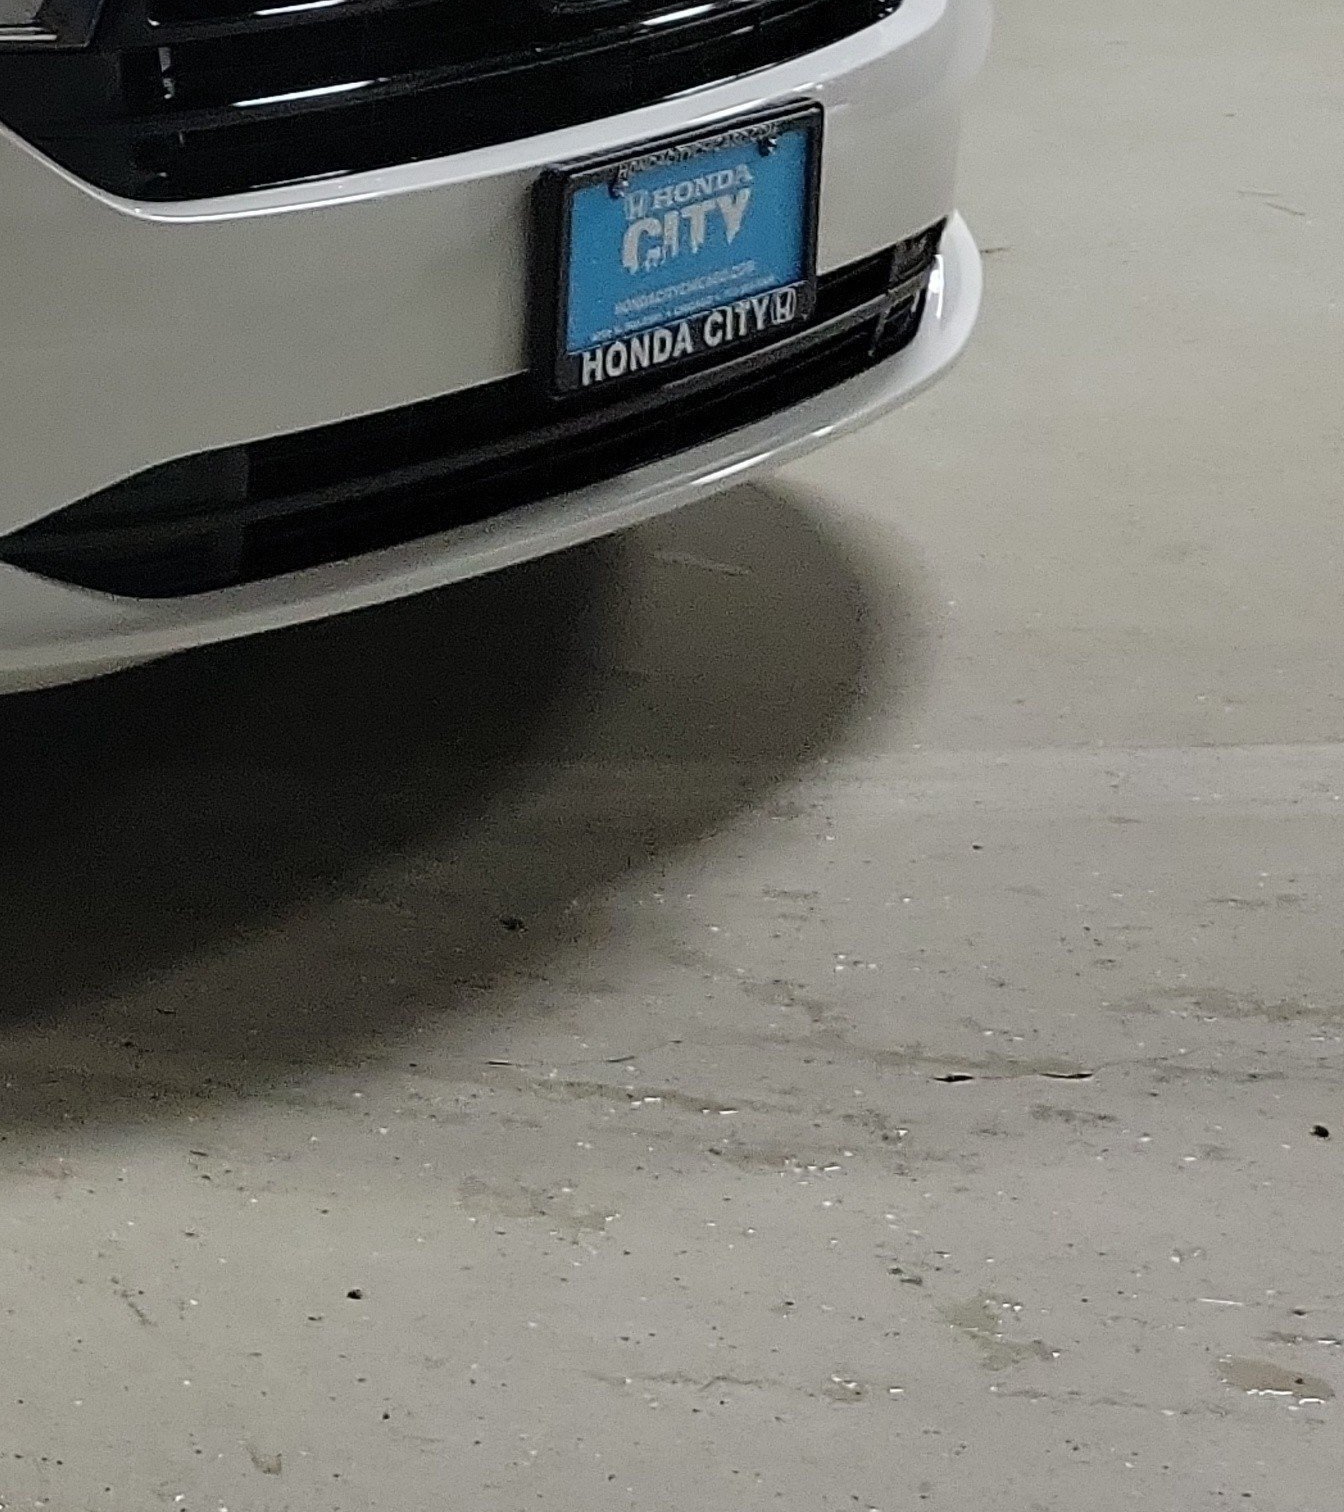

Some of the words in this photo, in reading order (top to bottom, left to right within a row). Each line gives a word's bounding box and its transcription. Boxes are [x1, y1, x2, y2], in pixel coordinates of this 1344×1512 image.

[652, 163, 754, 208] HONDA
[621, 188, 752, 274] CITY
[582, 321, 694, 385] HONDA
[704, 297, 771, 348] CITY
